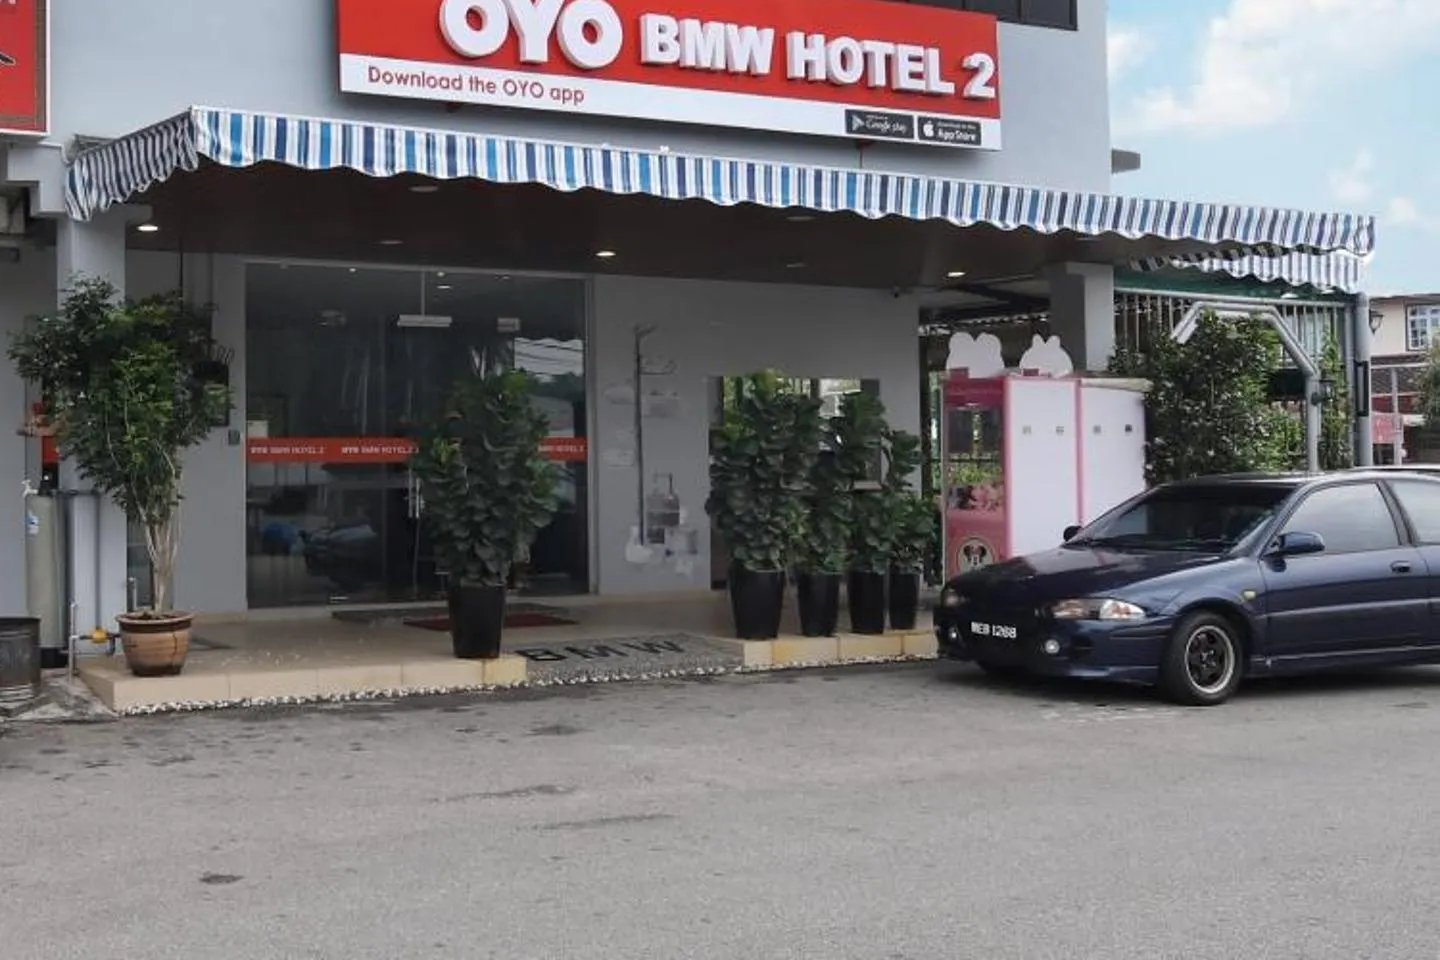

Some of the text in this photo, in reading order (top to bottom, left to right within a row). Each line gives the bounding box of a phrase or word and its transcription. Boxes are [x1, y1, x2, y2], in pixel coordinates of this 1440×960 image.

[368, 66, 585, 106] Download the OYO app
[640, 13, 774, 75] BMW
[786, 31, 955, 95] HOTEL
[962, 52, 996, 98] 2
